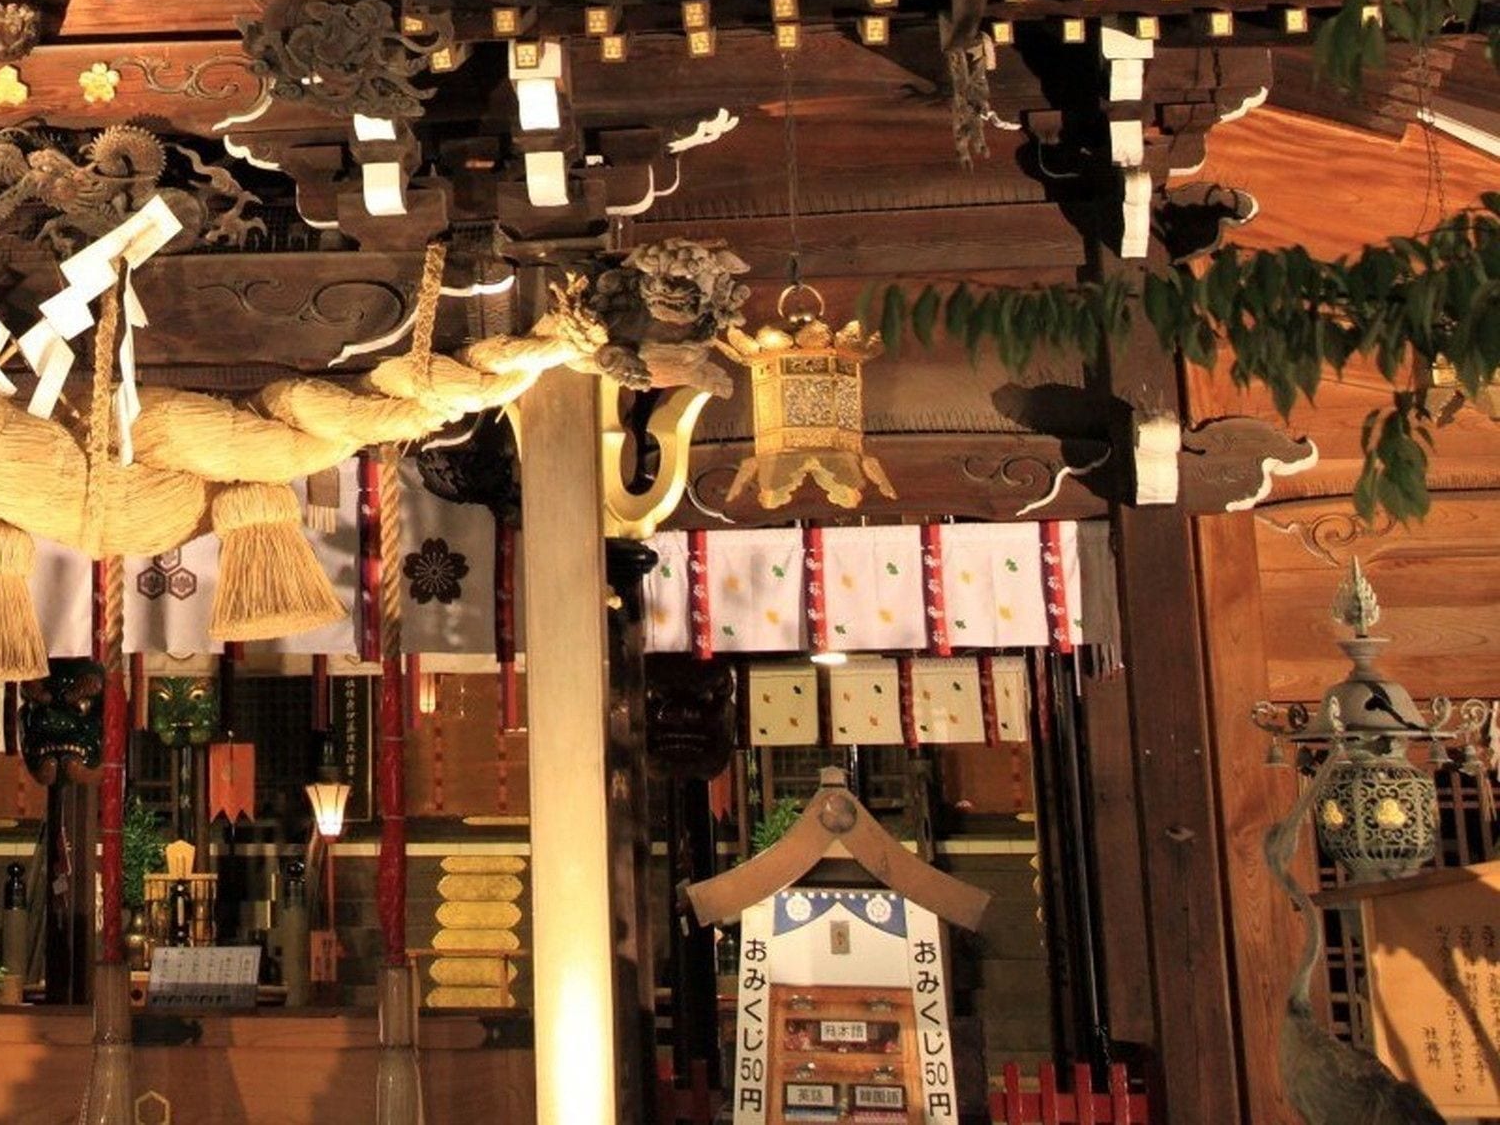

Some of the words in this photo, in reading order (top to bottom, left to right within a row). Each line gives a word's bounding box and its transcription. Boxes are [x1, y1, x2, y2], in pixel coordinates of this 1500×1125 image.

[740, 939, 767, 1113] おみくじ50円
[823, 1026, 865, 1039] 日本語
[914, 940, 951, 1117] おみくじ50円
